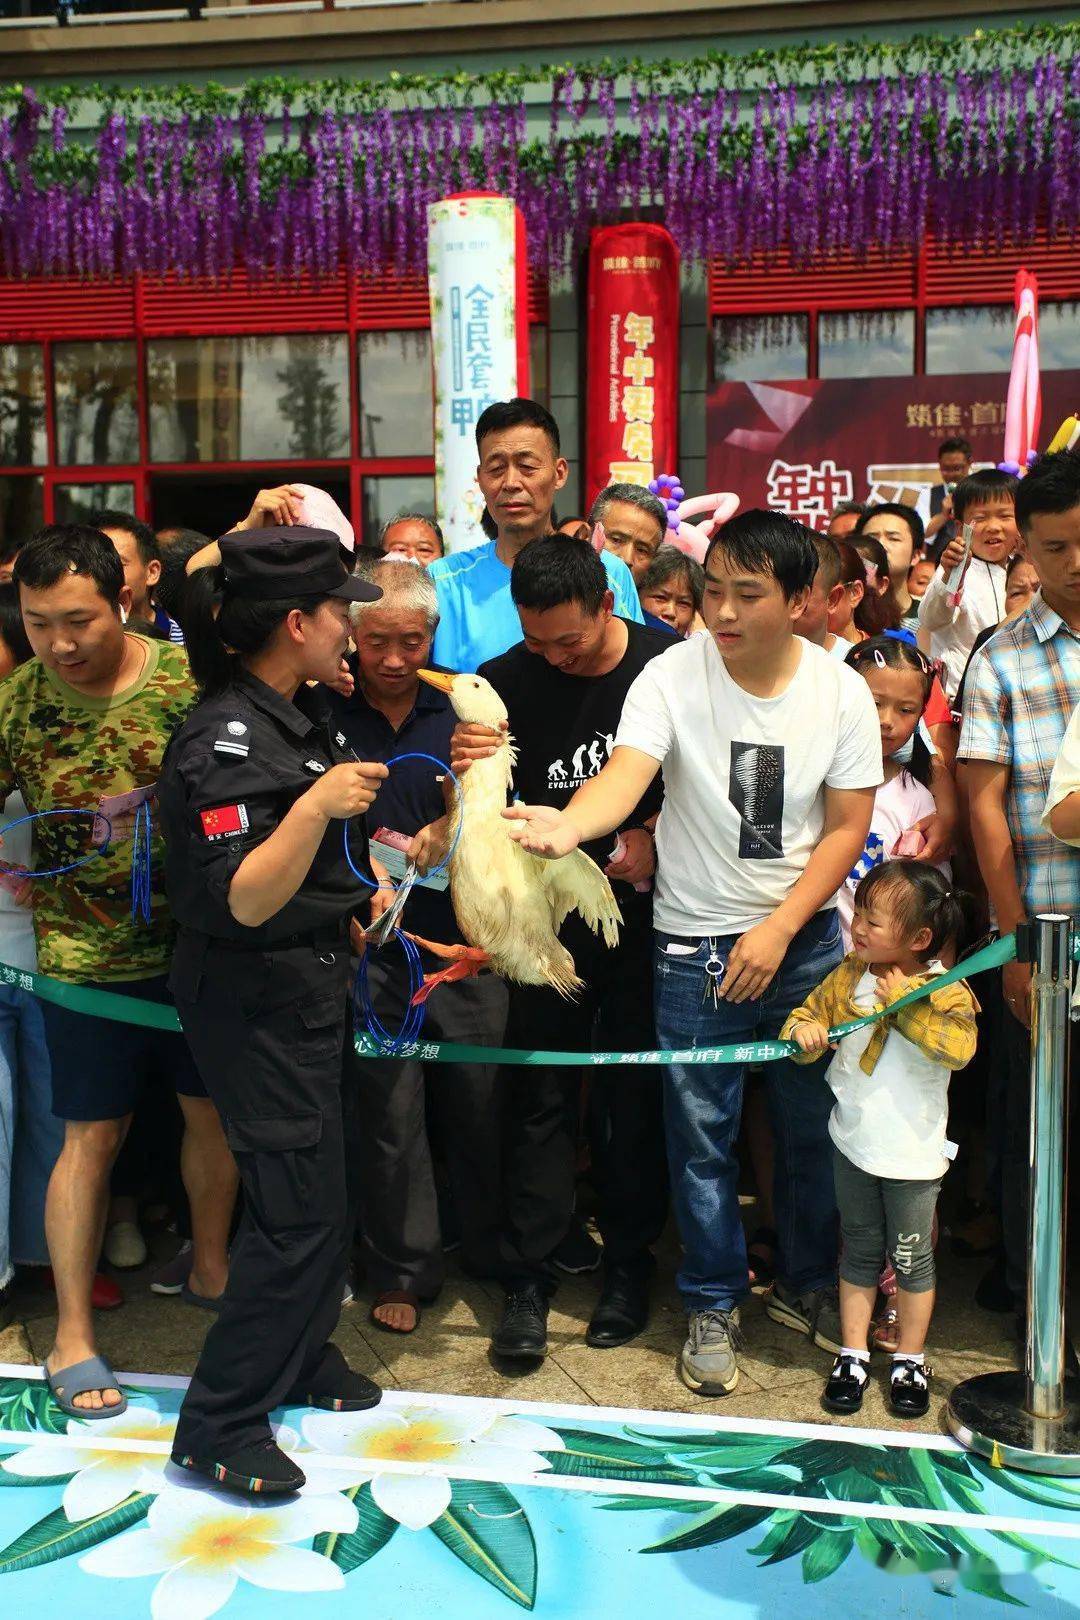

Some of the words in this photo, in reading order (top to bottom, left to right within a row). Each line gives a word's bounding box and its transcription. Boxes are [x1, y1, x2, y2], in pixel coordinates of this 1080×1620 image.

[906, 402, 1006, 428] 筑佳·首
[734, 1043, 797, 1061] 新中心
